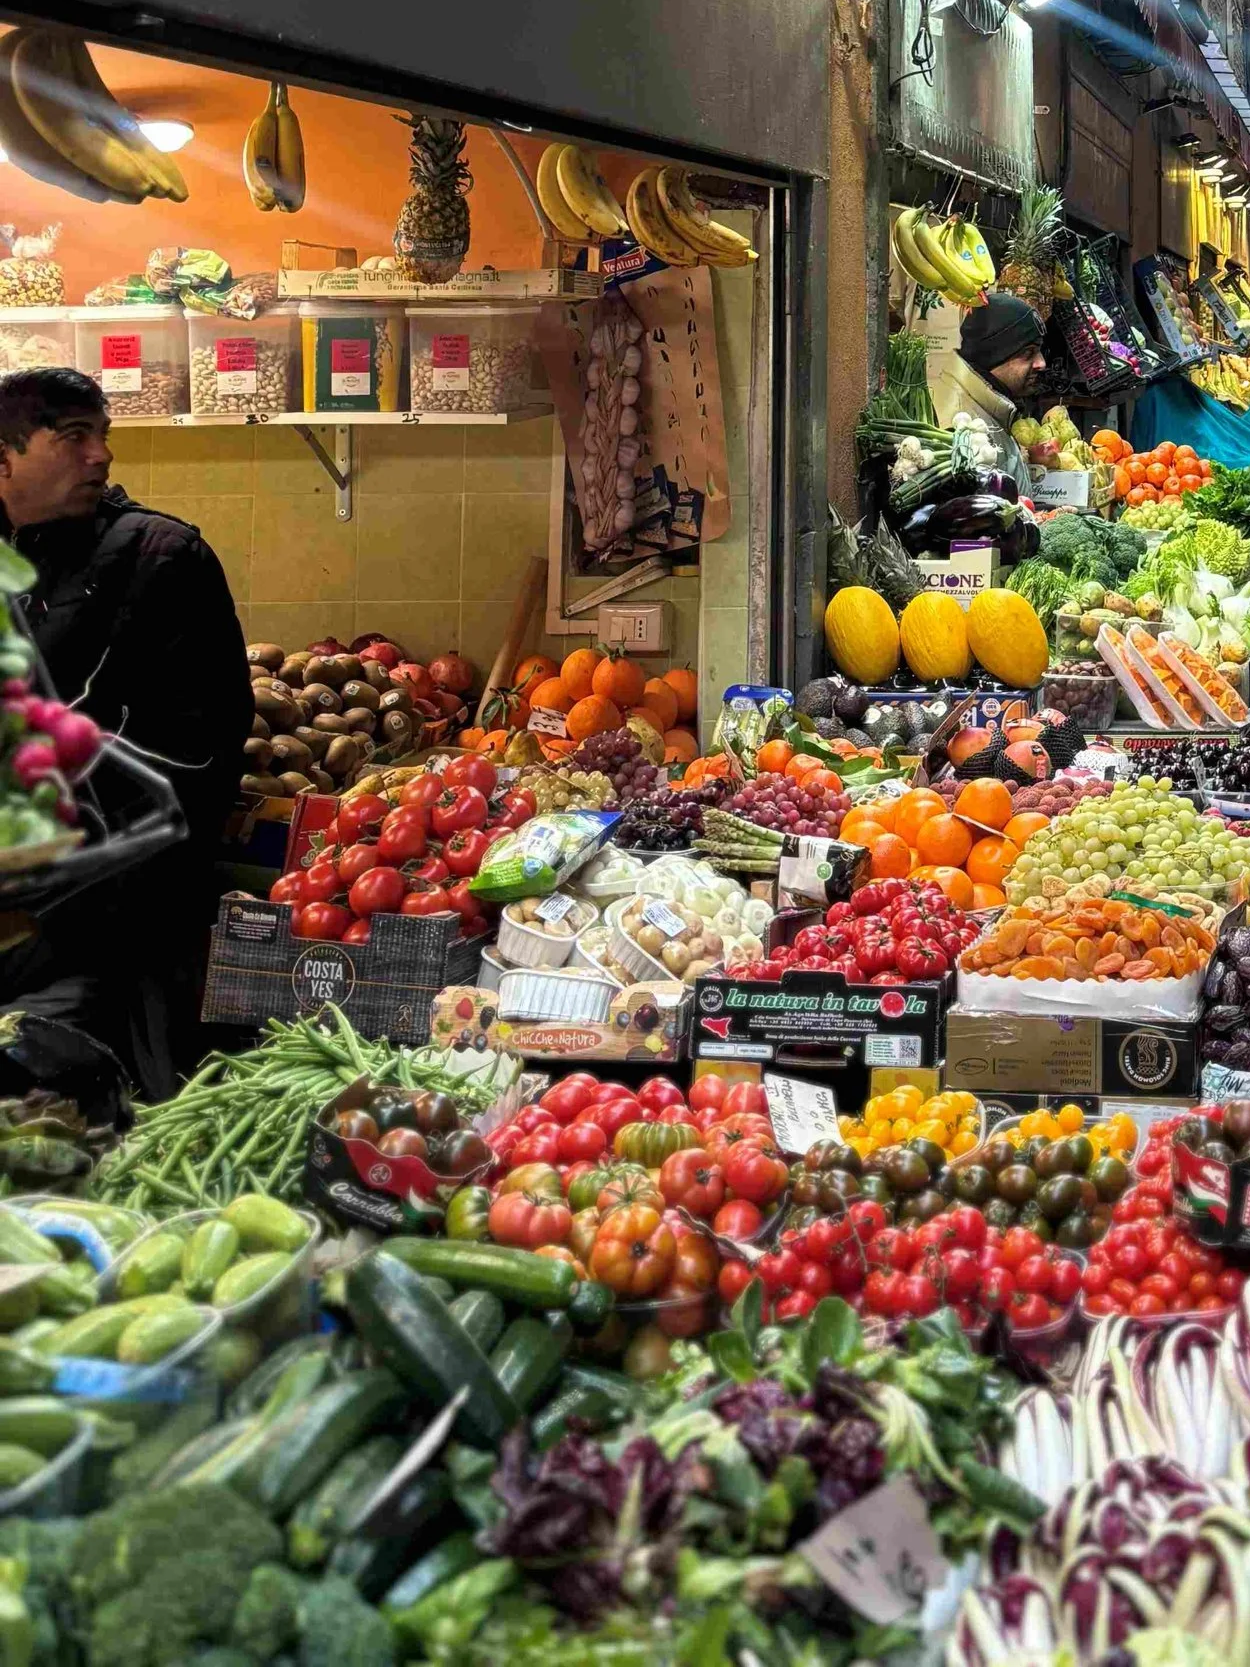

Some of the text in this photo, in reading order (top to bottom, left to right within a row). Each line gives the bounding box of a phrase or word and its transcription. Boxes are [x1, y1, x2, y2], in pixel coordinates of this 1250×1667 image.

[603, 257, 641, 273] Ventura
[401, 413, 423, 425] 25
[303, 959, 344, 981] COSTA
[310, 979, 334, 999] YES
[725, 988, 748, 1007] la
[748, 993, 819, 1010] natura
[821, 992, 845, 1010] in
[559, 1031, 596, 1050] Natura
